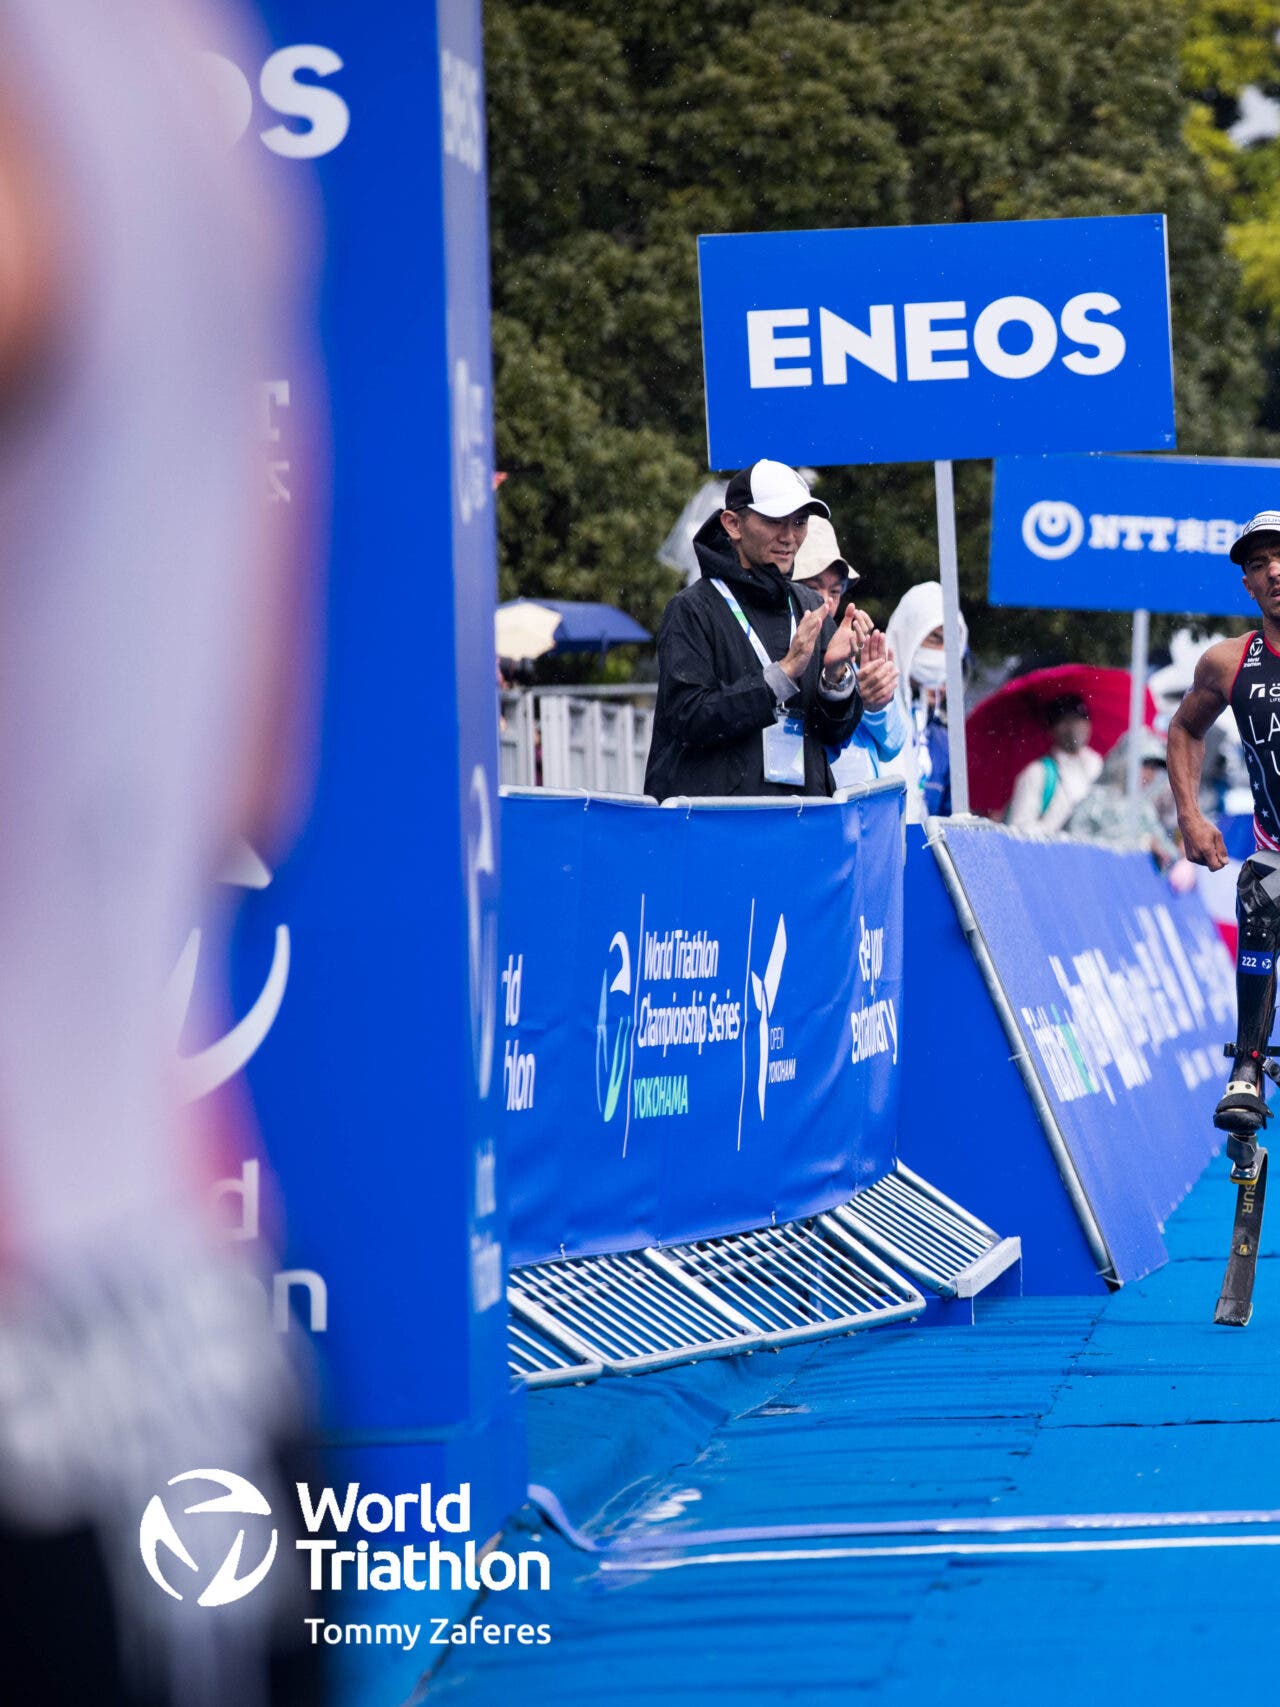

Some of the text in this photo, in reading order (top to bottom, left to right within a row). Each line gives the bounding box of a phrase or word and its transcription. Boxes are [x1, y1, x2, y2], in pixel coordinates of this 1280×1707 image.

[746, 292, 1126, 389] ENEOS
[1089, 513, 1248, 555] NTT東日
[643, 929, 720, 981] World Triathlon
[1241, 956, 1257, 968] 222
[637, 989, 741, 1058] Championship Series
[633, 1074, 689, 1120] YOKOHAMA
